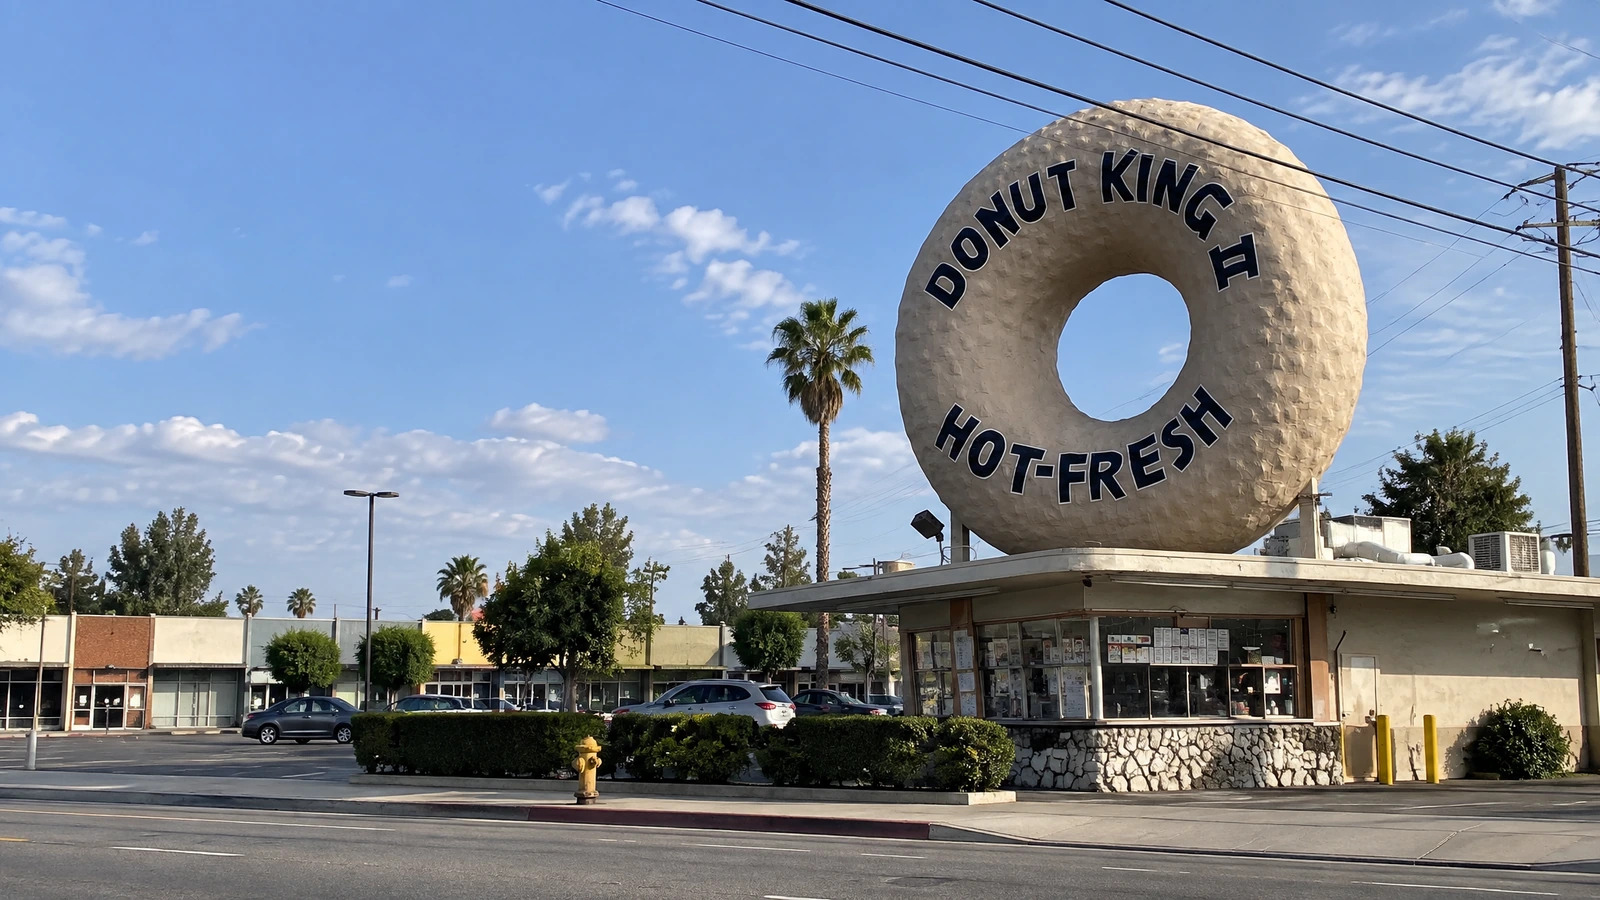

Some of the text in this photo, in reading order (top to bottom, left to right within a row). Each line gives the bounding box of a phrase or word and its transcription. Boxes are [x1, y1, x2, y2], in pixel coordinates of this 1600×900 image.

[924, 148, 1260, 311] DONUT KING II
[934, 385, 1235, 504] HOT-FRESH
